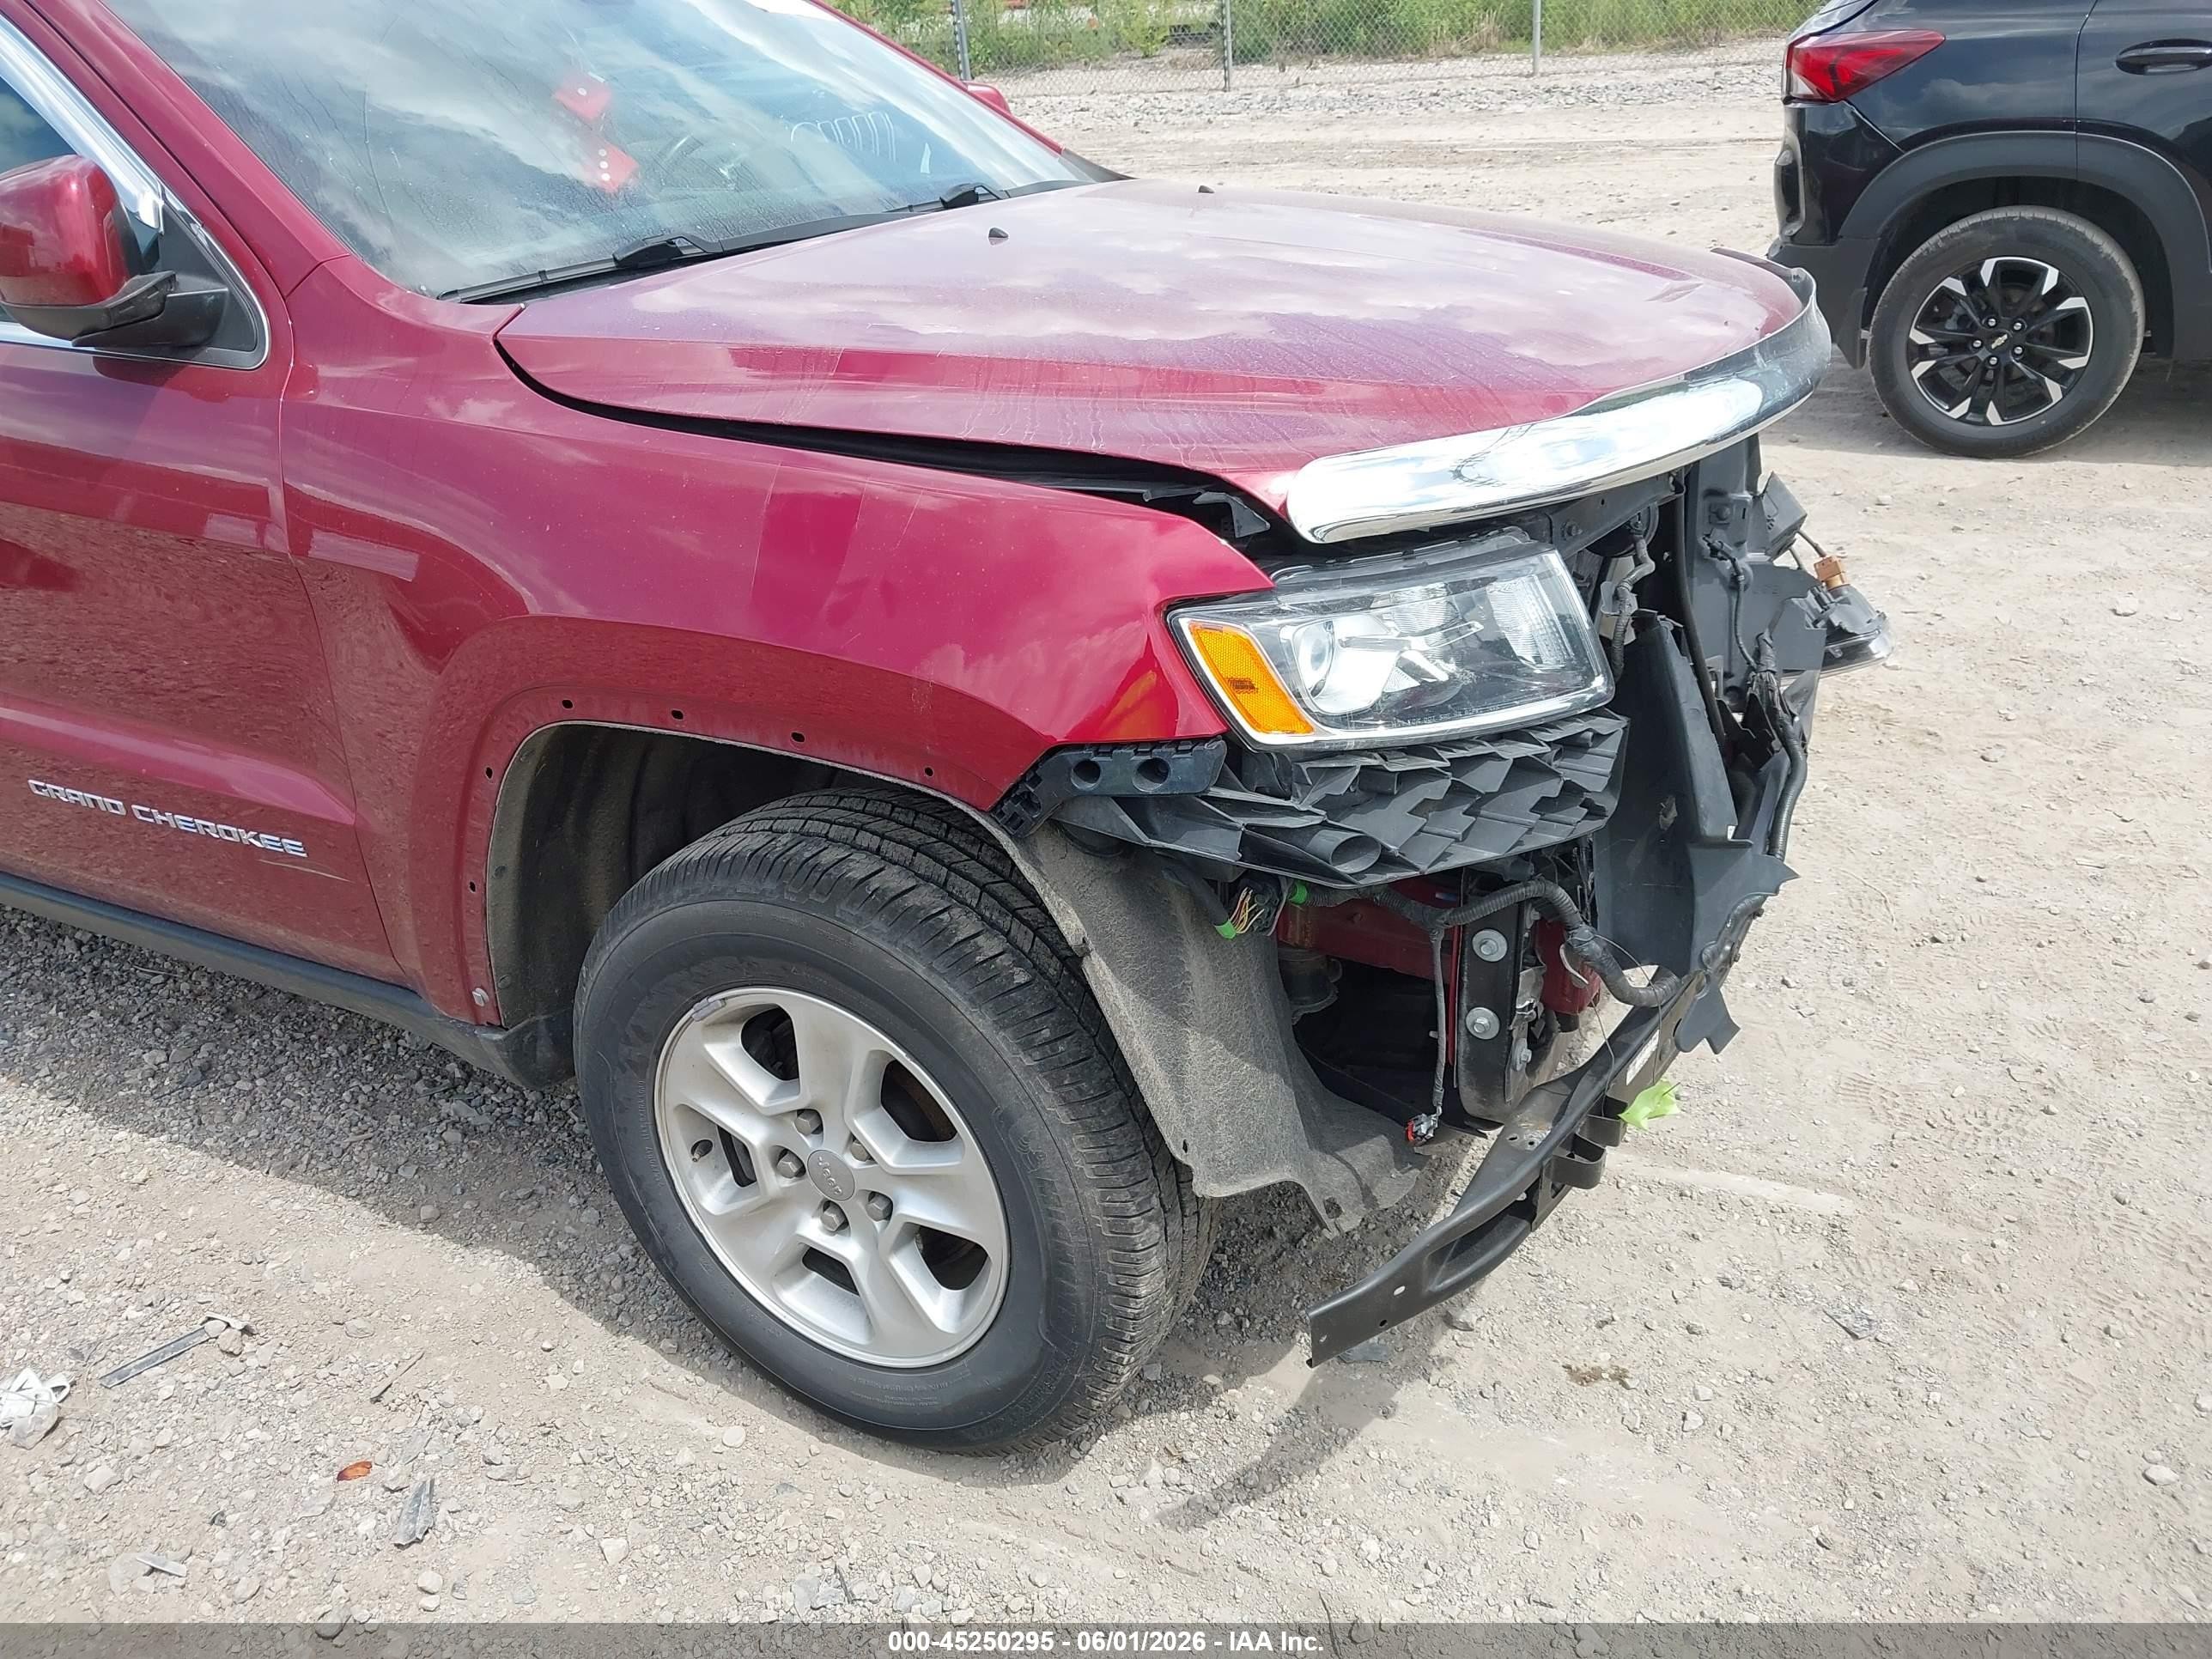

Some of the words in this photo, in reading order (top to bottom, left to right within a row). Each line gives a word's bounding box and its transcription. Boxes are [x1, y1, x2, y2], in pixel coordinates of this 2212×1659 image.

[27, 779, 127, 816] GRAND
[131, 804, 308, 858] CHEROKEE
[817, 1156, 843, 1196] Jeep
